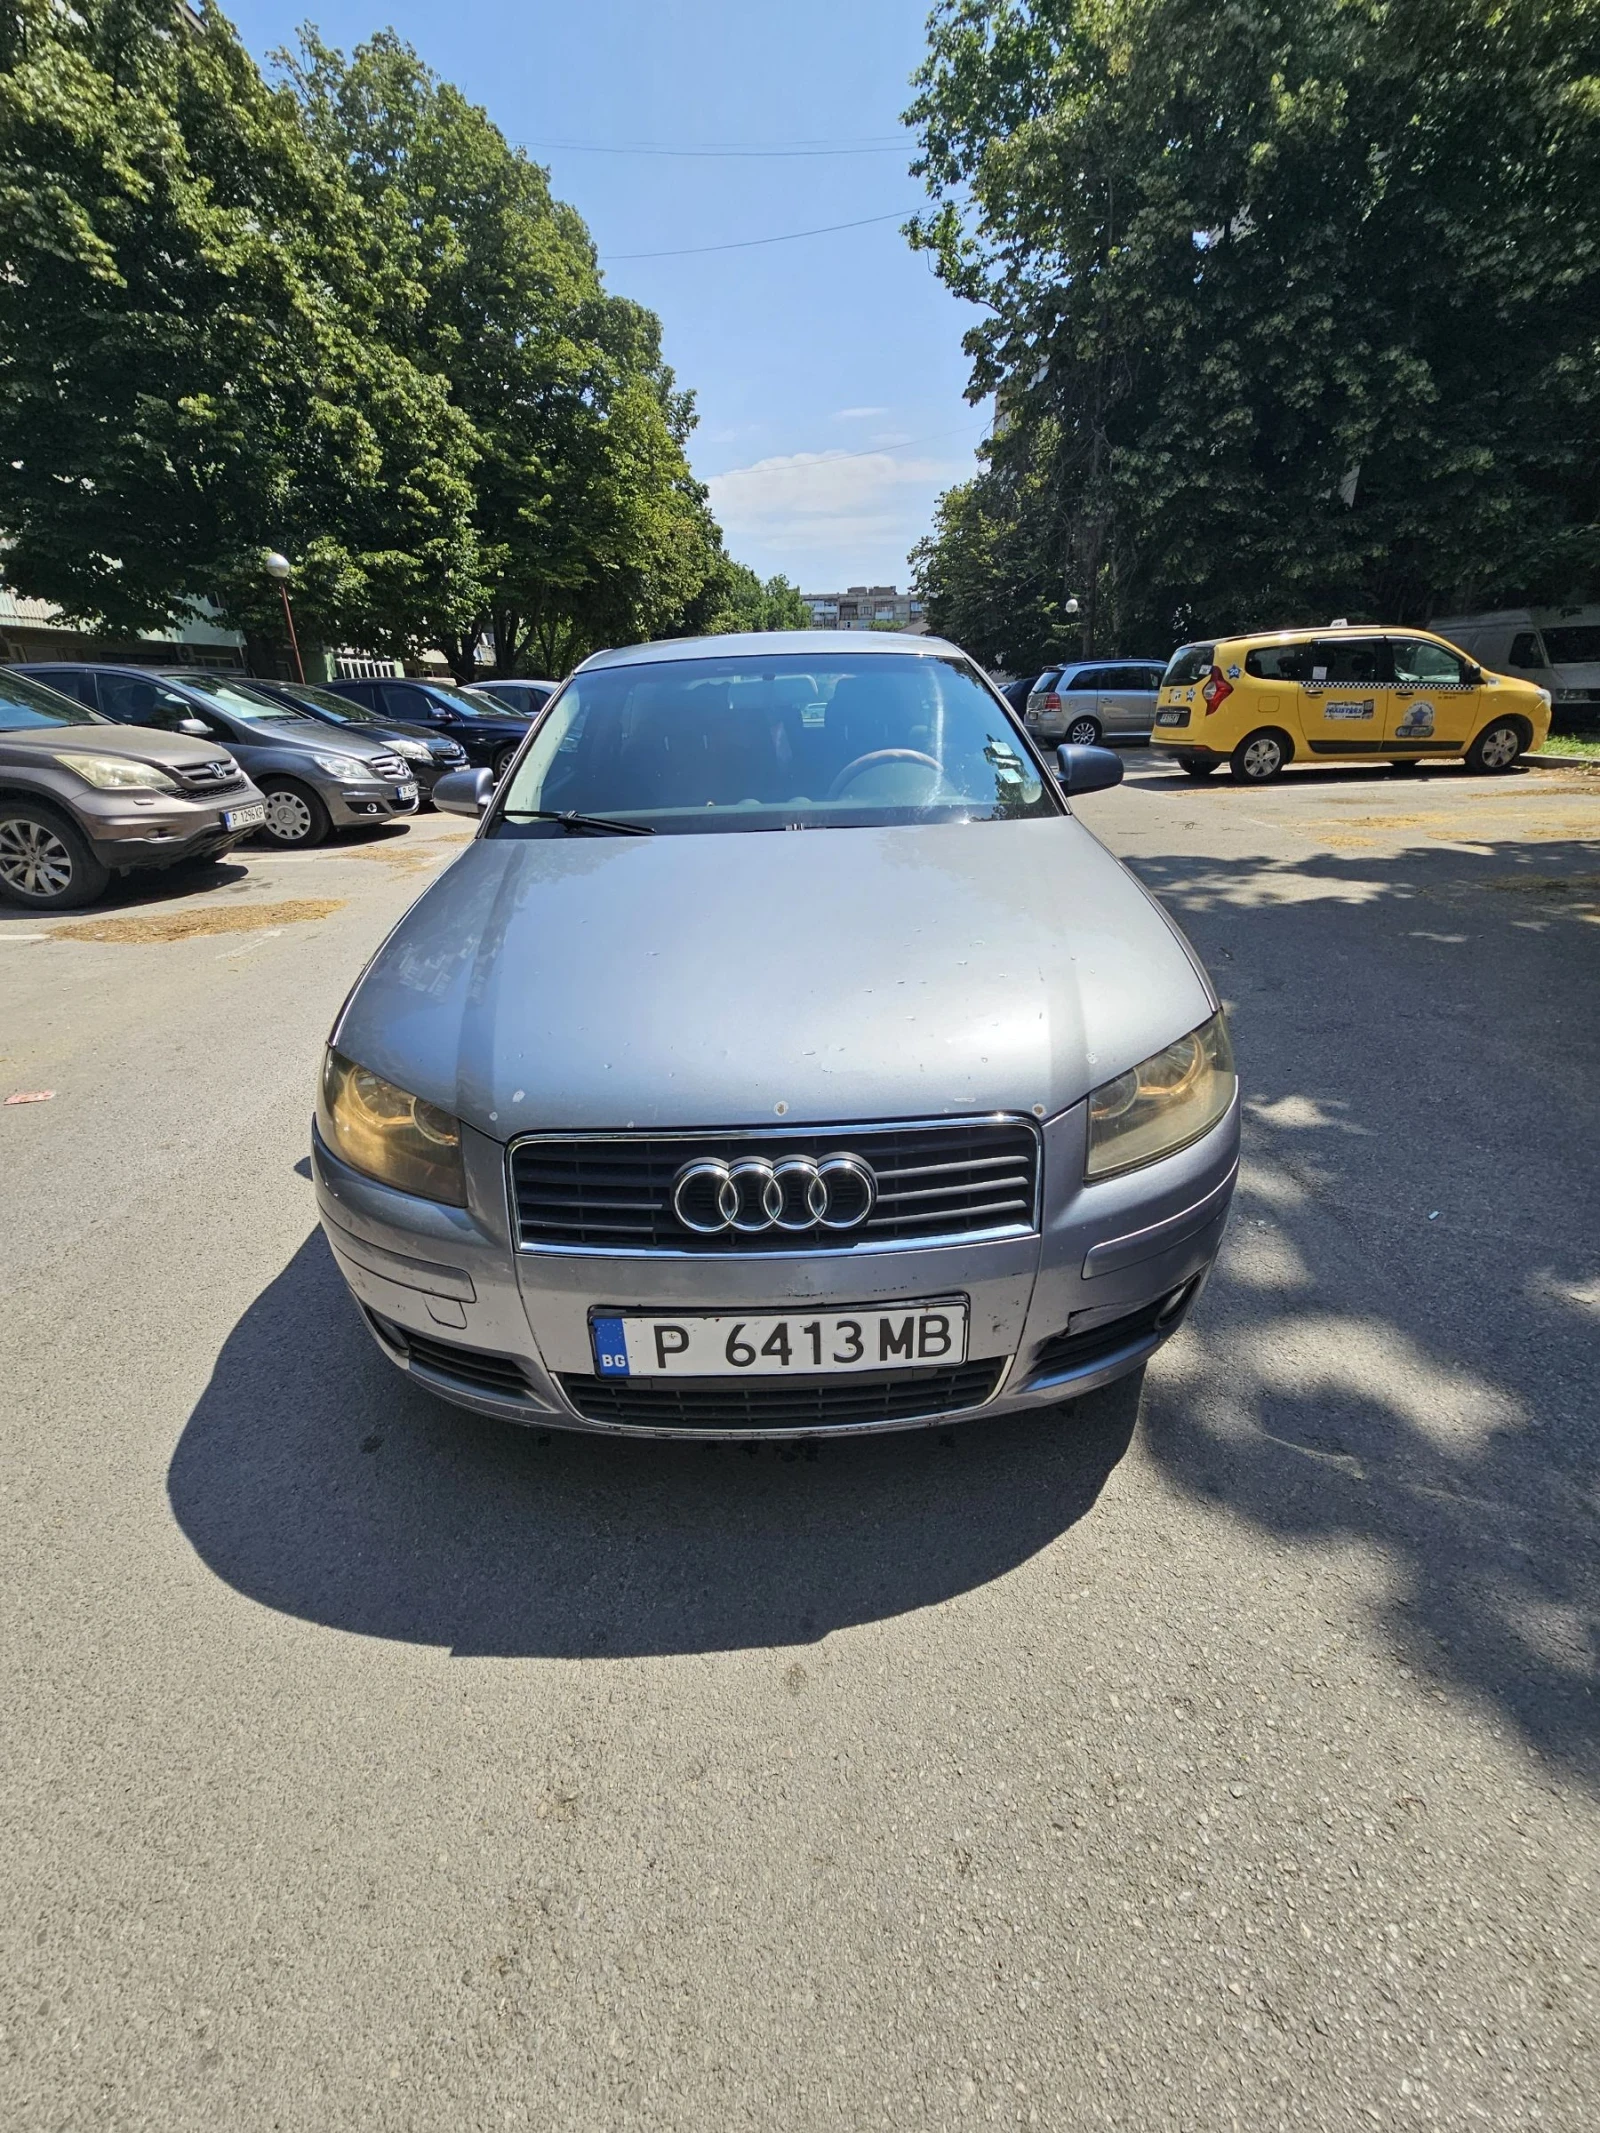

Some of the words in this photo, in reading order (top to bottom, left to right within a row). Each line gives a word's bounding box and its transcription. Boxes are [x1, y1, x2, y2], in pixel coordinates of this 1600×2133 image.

[232, 812, 238, 825] P
[654, 1325, 690, 1369] P
[602, 1354, 626, 1368] BG
